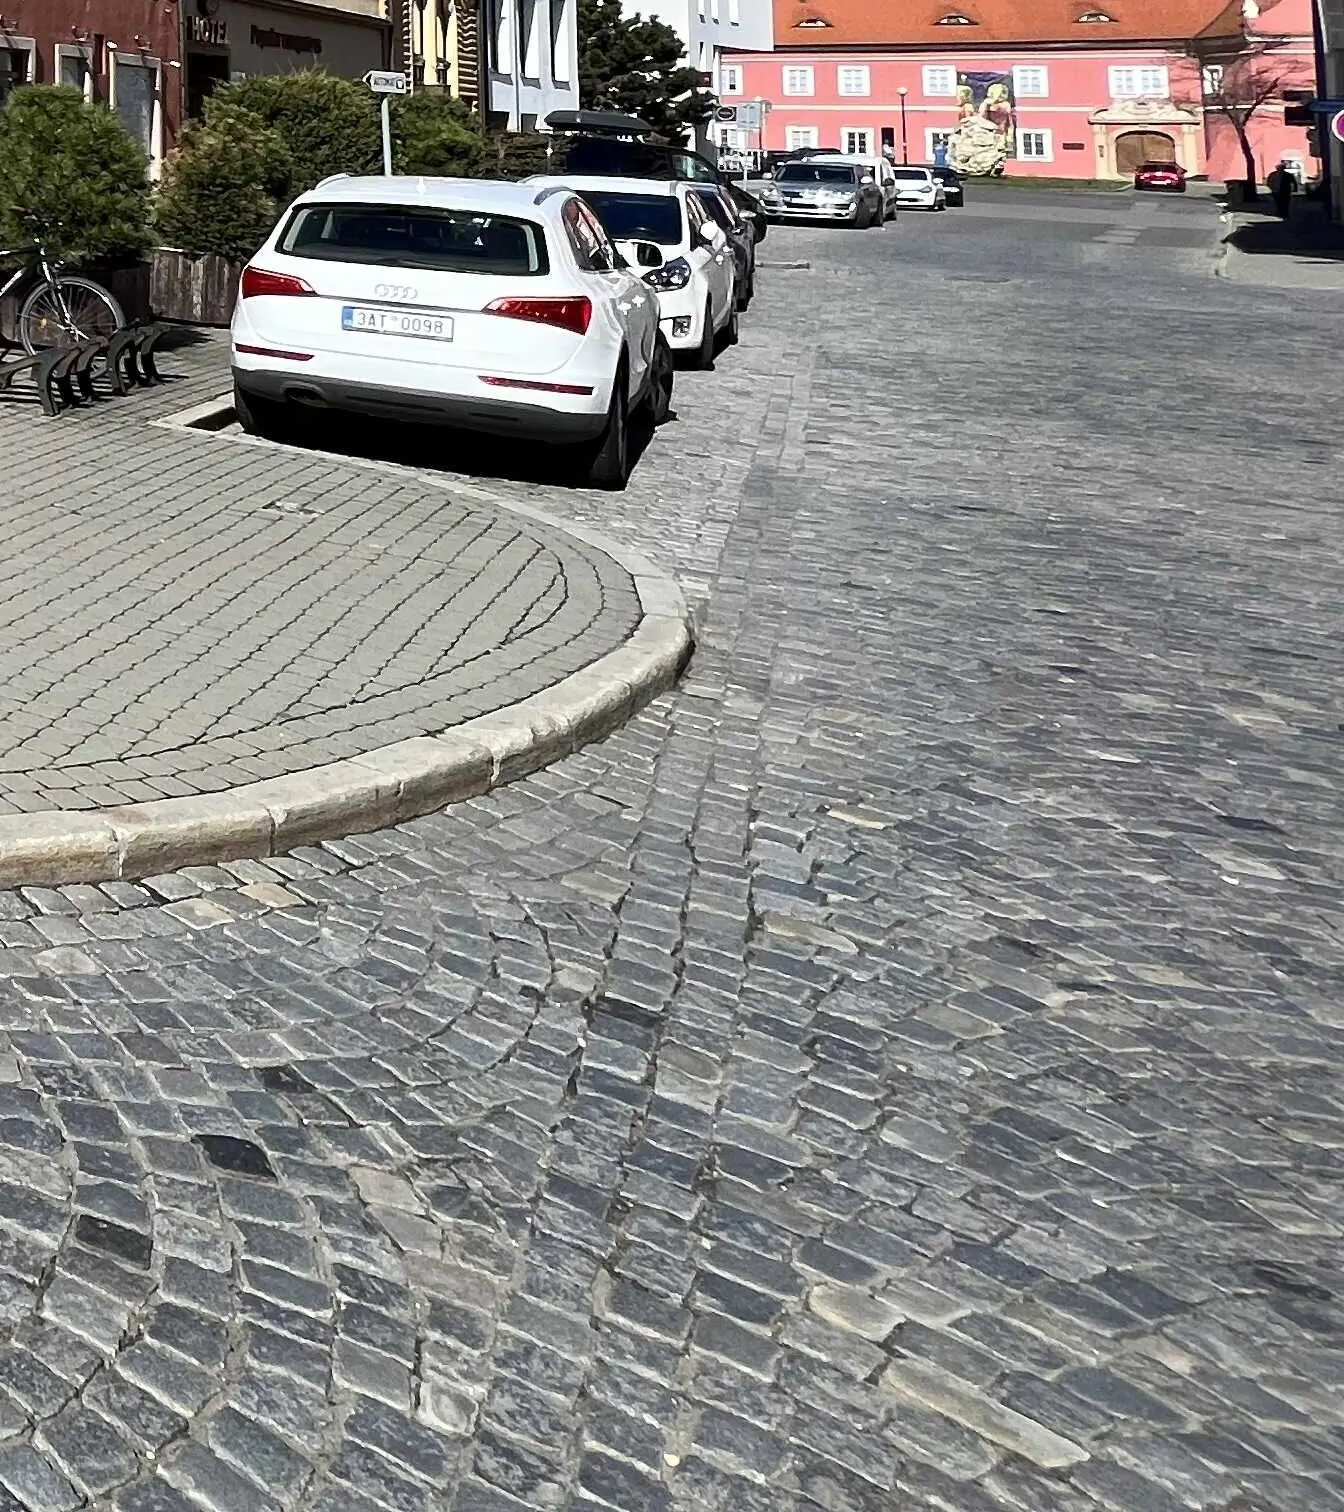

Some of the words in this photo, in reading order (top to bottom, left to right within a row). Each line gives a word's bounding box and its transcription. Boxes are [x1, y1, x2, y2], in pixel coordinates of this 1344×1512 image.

[190, 15, 231, 45] HOTEL
[357, 311, 388, 329] 3AT
[400, 316, 444, 335] 0098
